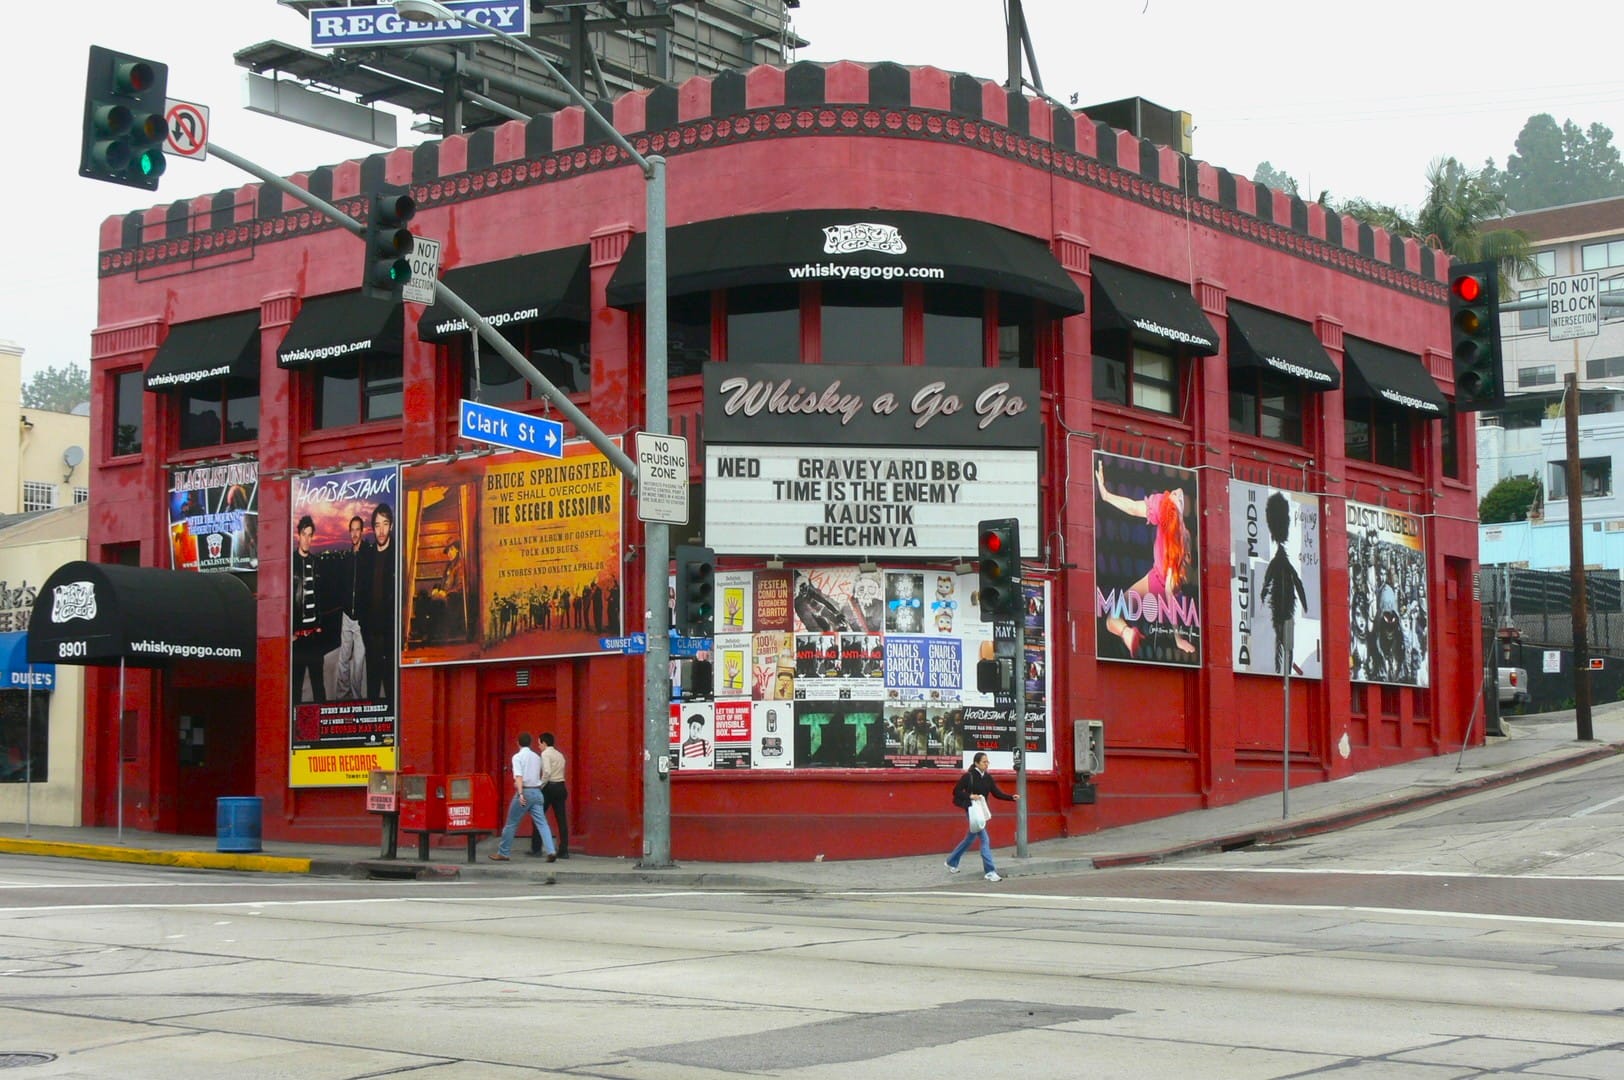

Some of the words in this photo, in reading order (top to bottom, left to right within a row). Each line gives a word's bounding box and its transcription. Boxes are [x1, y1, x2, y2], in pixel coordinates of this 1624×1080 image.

[417, 242, 438, 259] NOT
[408, 259, 436, 279] OCK
[788, 262, 945, 280] whiskyagogo.com
[1551, 280, 1567, 296] DO
[1572, 276, 1597, 293] NOT
[1551, 295, 1596, 314] BLOCK
[1551, 312, 1597, 328] INTERSECTION
[1133, 319, 1212, 346] whiskyagogo.com
[281, 338, 372, 364] whiskyagogo.com
[147, 363, 231, 387] whiskyagogo.com
[1265, 356, 1333, 382] whiskyagogo.com
[719, 376, 864, 425] Whisky
[871, 391, 899, 416] a
[910, 380, 965, 429] Go
[975, 381, 1028, 430] Go
[1380, 388, 1440, 411] whiskyagogo.com
[466, 410, 508, 437] Clark
[517, 423, 536, 444] St
[655, 441, 669, 453] NO
[640, 452, 685, 468] CRUISING
[487, 471, 525, 491] BRUCE
[530, 460, 618, 489] SPRINGSTEEN
[650, 466, 677, 479] ZONE
[717, 457, 761, 479] WED
[798, 458, 928, 481] GRAVEYARD
[930, 460, 978, 482] BBQ
[500, 492, 515, 503] WE
[517, 490, 546, 501] SHALL
[549, 481, 603, 498] OVERCOME
[772, 480, 822, 501] TIME
[827, 481, 846, 501] IS
[850, 481, 887, 502] THE
[892, 483, 961, 503] ENEMY
[492, 506, 510, 525] THE
[514, 499, 554, 523] SEEGER
[558, 494, 612, 518] SESSIONS
[824, 504, 914, 525] KAUSTIK
[1346, 504, 1419, 538] DISTURBED
[509, 537, 522, 546] ALL
[523, 535, 538, 545] NEW
[540, 533, 563, 543] ALBUM
[805, 526, 918, 548] CHECHNYA
[521, 548, 539, 557] FOLK
[541, 546, 555, 556] AND
[498, 569, 507, 578] IN
[507, 567, 532, 577] STORES
[533, 566, 547, 576] AND
[547, 564, 572, 574] ONLINE
[573, 562, 593, 572] APRIL
[1096, 585, 1201, 628] MADONNA
[58, 641, 88, 658] 8901
[130, 640, 242, 658] whiskyagogo.com
[606, 638, 632, 649] SUNSET
[677, 638, 703, 650] CLARK
[886, 643, 919, 658] GNARLS
[928, 644, 956, 659] GNARLS
[886, 657, 924, 672] BARKLEY
[929, 658, 961, 673] BARKLEY
[11, 672, 52, 685] DUKE'S
[887, 671, 896, 686] IS
[898, 671, 925, 687] CRAZY
[929, 672, 938, 687] IS
[938, 672, 961, 688] CRAZY
[308, 755, 336, 773] TOWER
[339, 754, 378, 773] RECORDS
